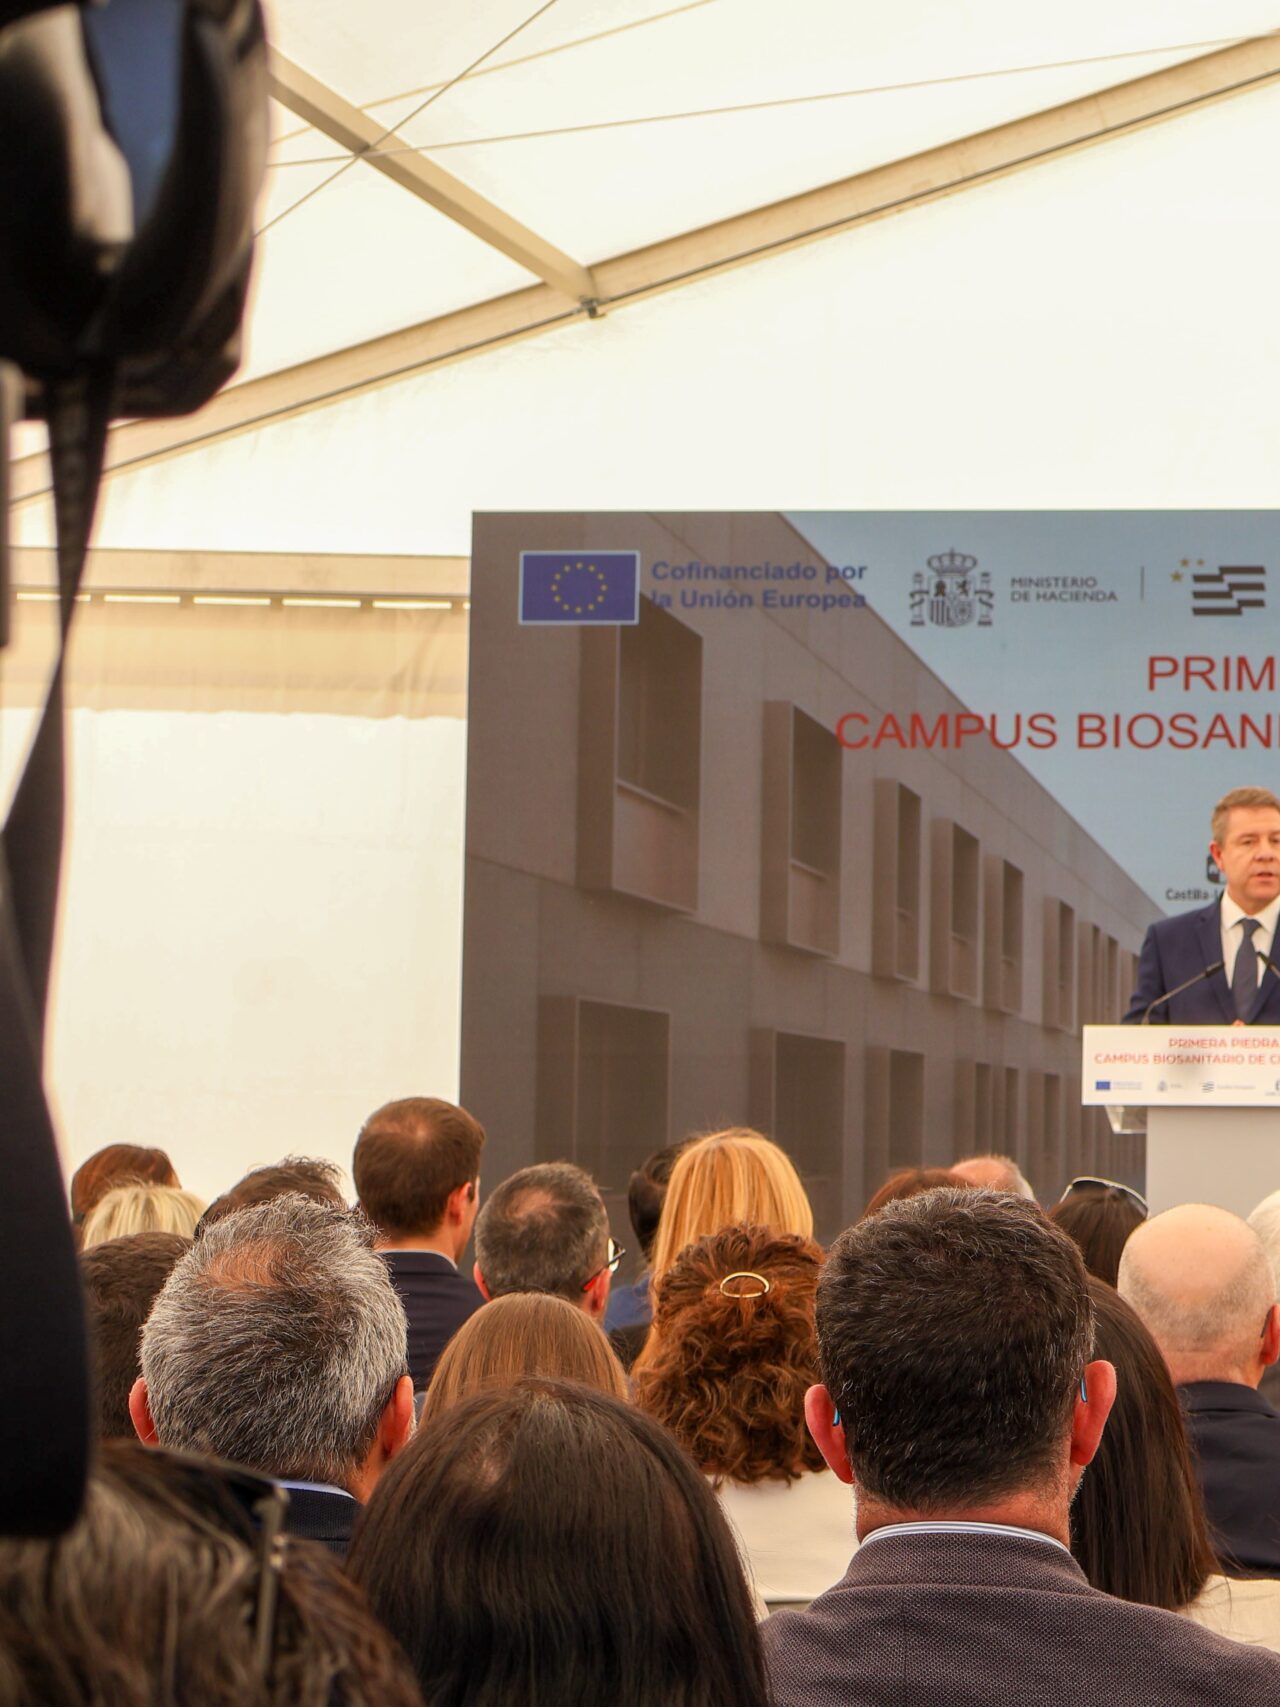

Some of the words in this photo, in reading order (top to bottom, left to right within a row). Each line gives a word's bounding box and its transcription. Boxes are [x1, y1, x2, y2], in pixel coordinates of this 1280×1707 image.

[651, 561, 817, 581] Cofinanciado
[825, 565, 868, 584] por
[1010, 576, 1098, 589] MINISTERIO
[651, 591, 673, 609] la
[680, 589, 754, 609] Unión
[762, 590, 866, 612] Europea
[1010, 589, 1031, 602] DE
[1036, 589, 1119, 602] HACIENDA
[834, 712, 1058, 750] CAMPUS
[1168, 1037, 1228, 1049] PRIMERA
[1231, 1037, 1280, 1049] PIEDRA
[1094, 1053, 1150, 1065] CAMPUS
[1152, 1053, 1245, 1065] BIOSANITARIO
[1248, 1053, 1266, 1065] DE
